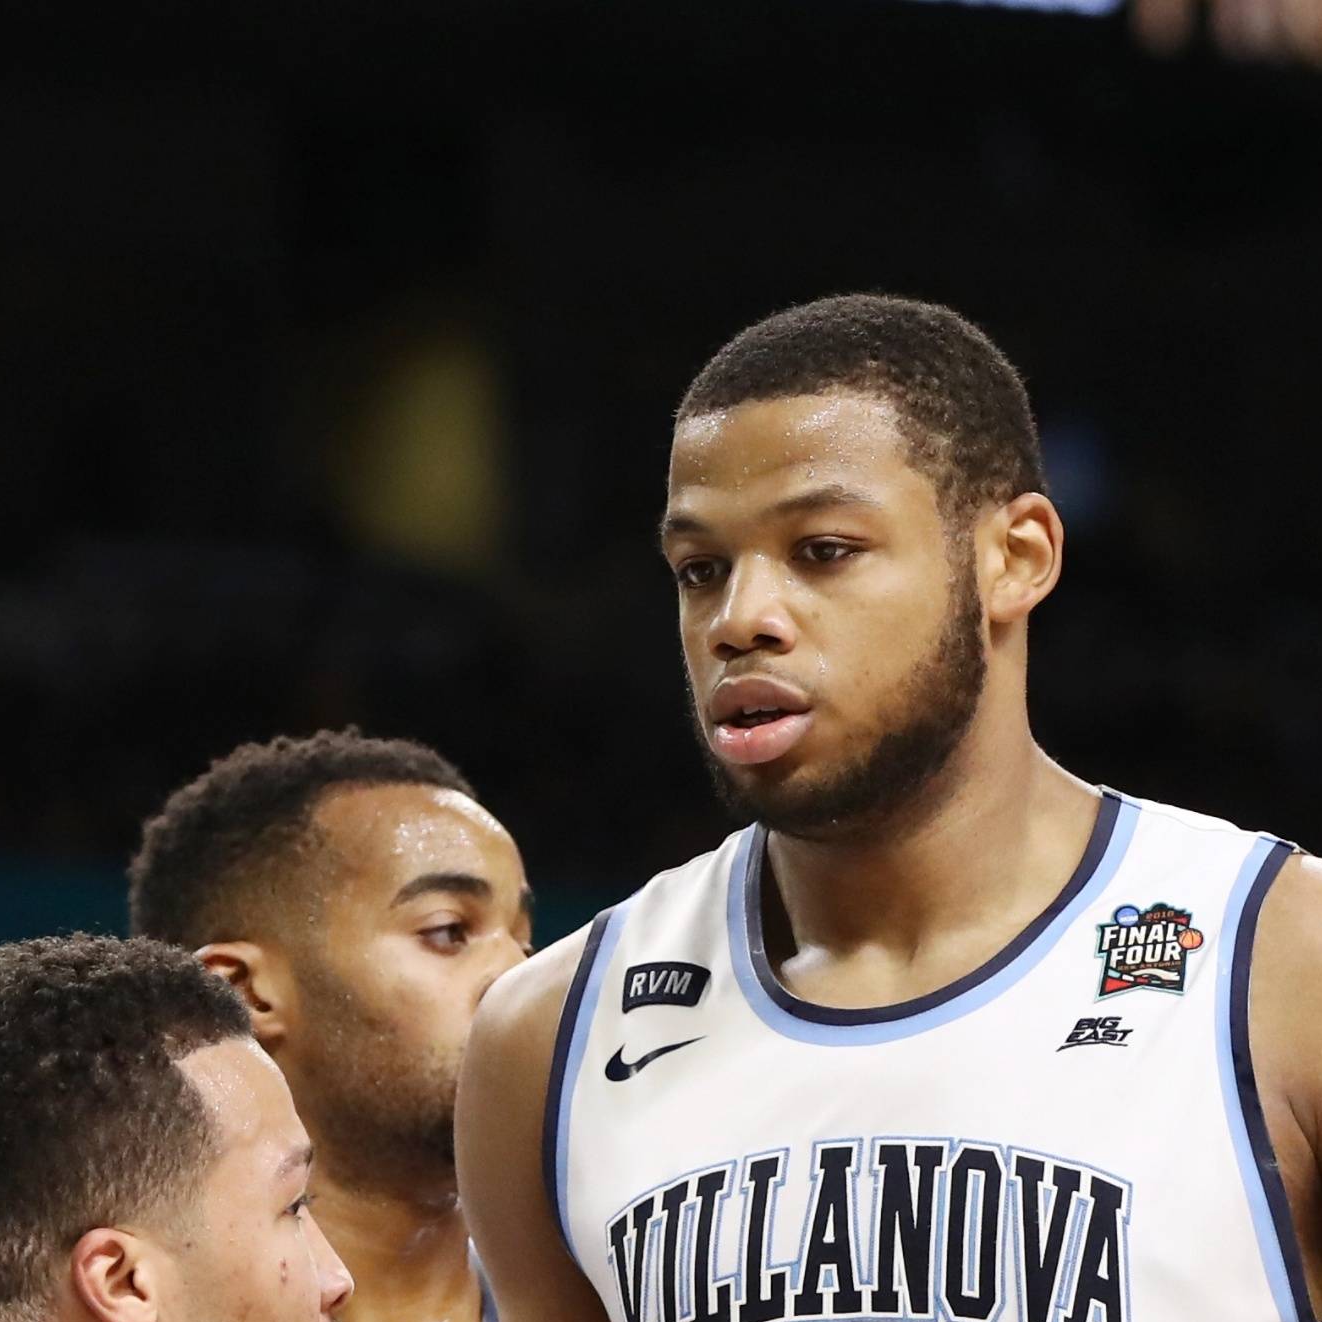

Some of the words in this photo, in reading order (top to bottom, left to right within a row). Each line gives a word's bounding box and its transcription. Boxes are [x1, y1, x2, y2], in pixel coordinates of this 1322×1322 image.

[1102, 921, 1178, 951] FINAL
[1109, 942, 1182, 969] FOUR
[629, 970, 693, 998] RVM
[1065, 1028, 1134, 1043] EAST
[1074, 1016, 1123, 1030] BIG
